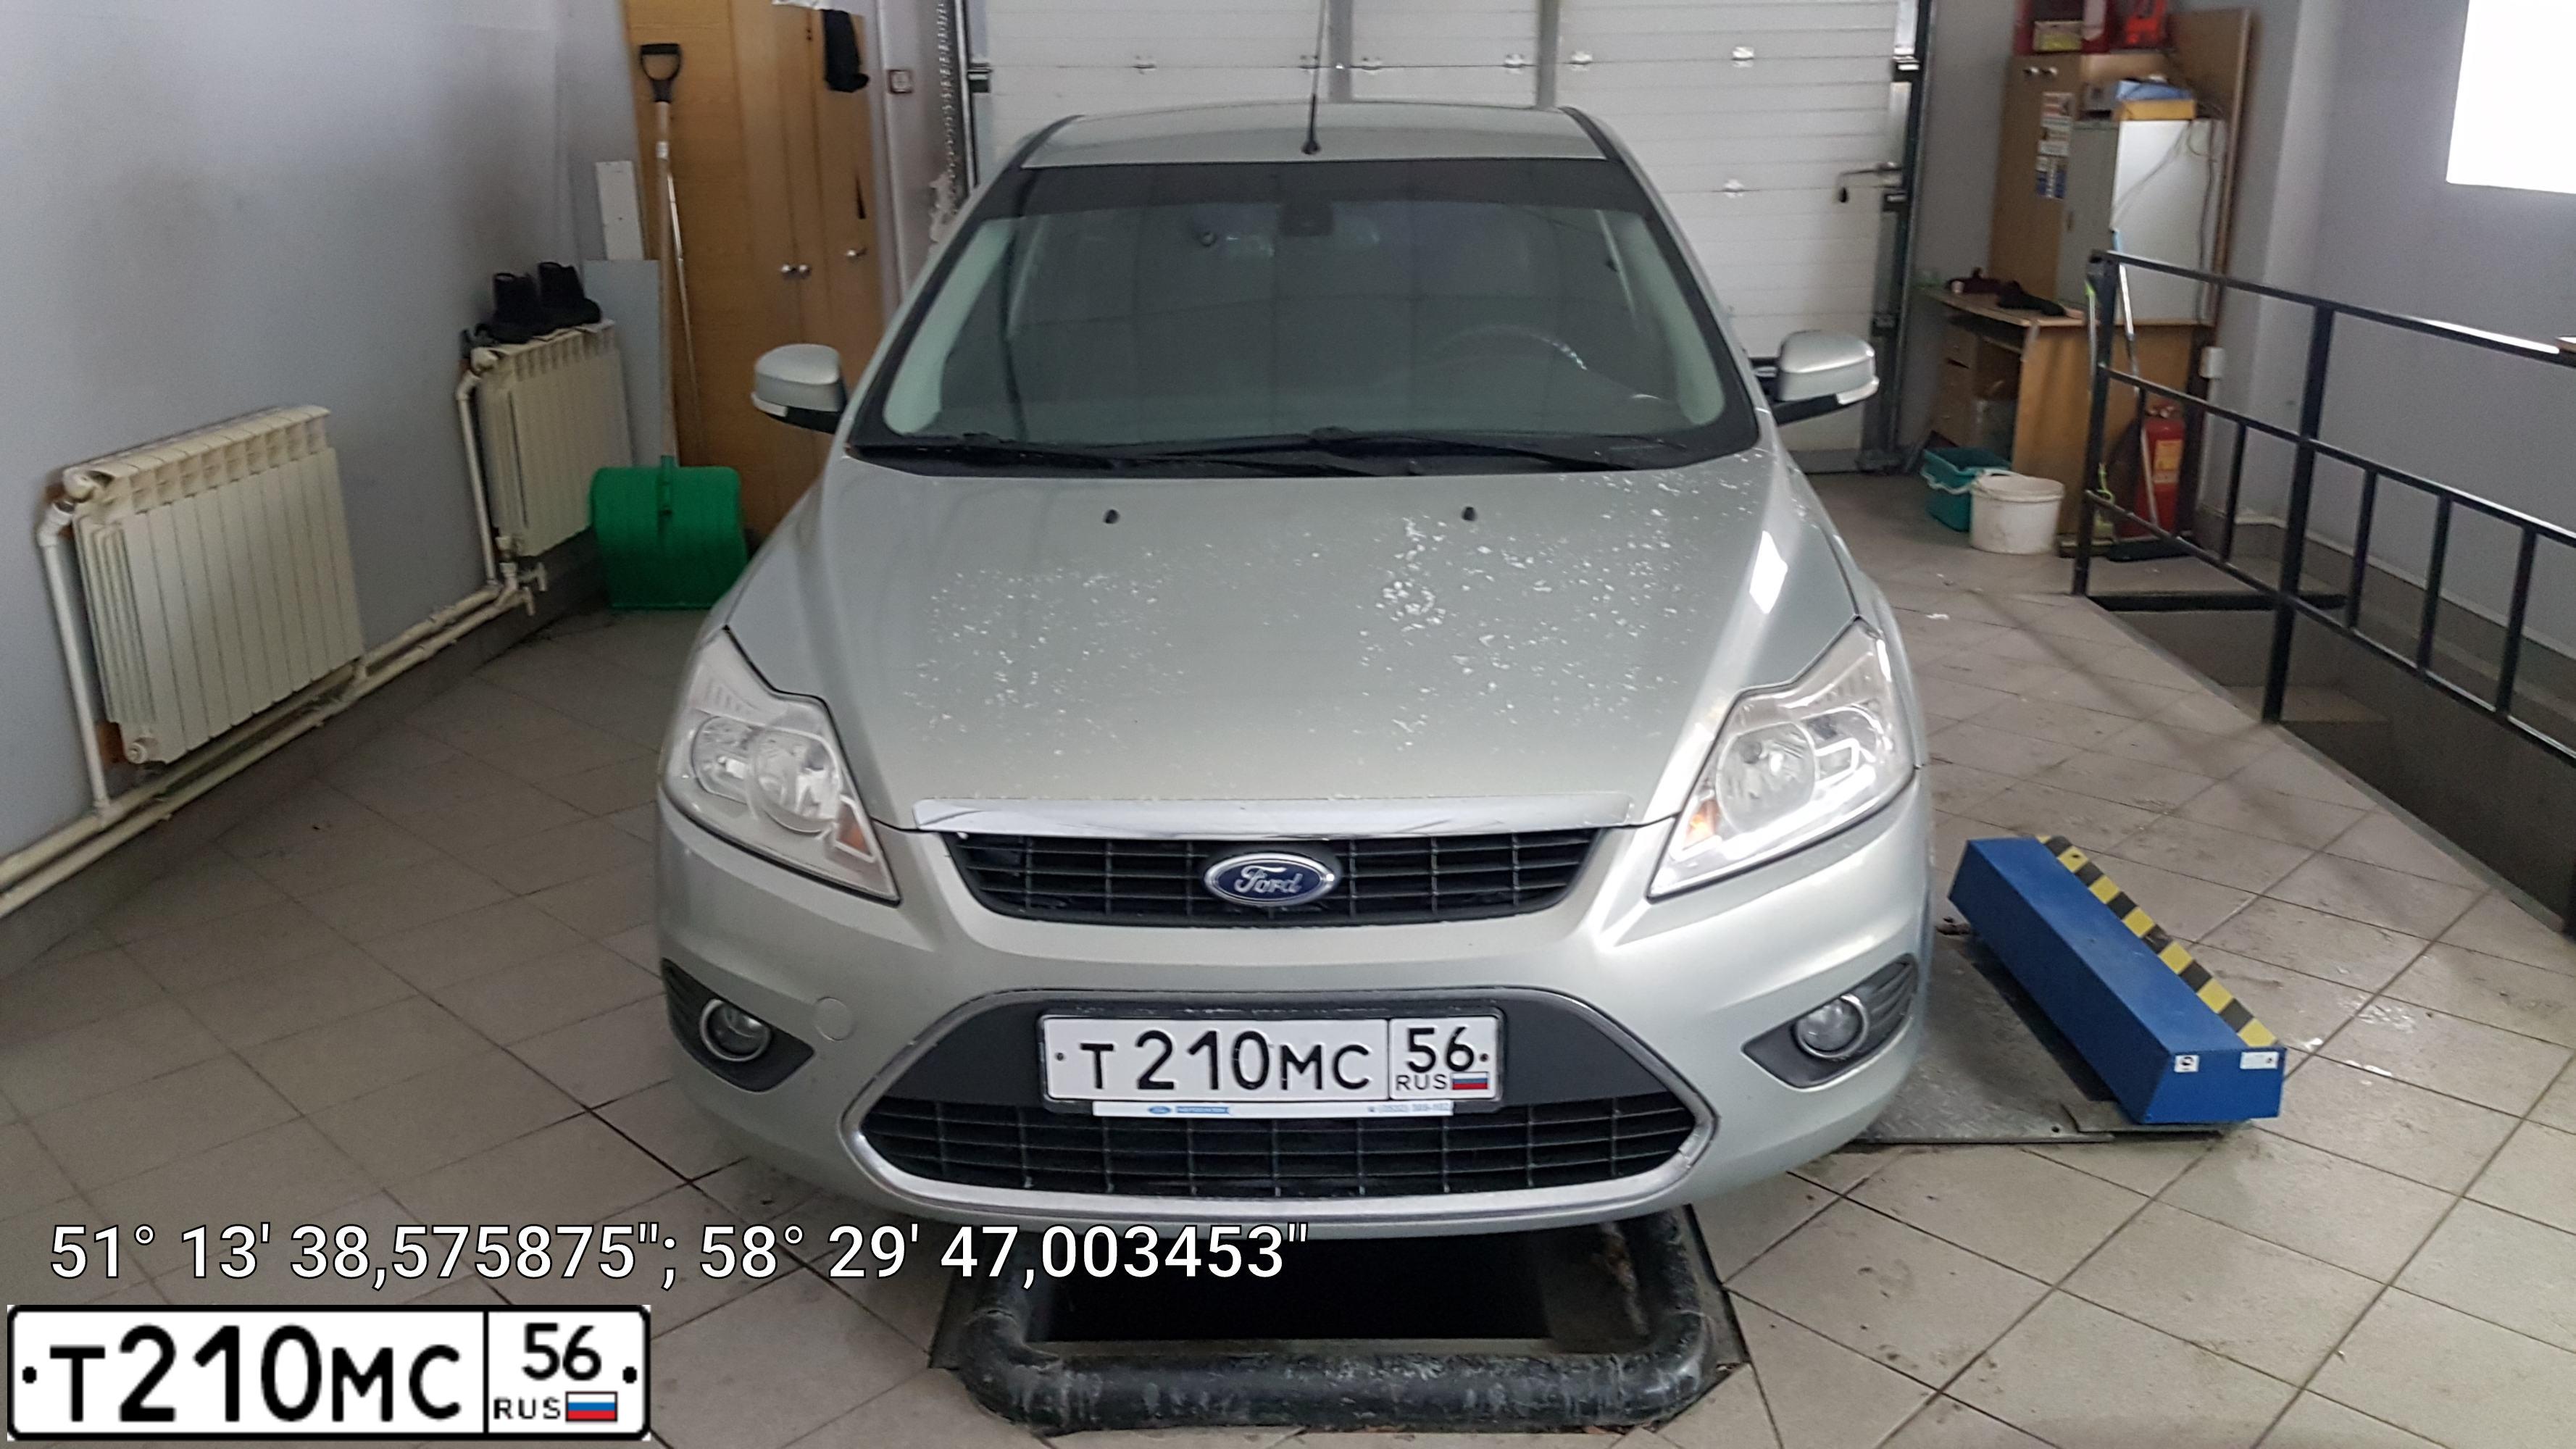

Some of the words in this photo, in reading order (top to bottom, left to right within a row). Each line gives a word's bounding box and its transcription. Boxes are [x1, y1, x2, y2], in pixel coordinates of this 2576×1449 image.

[1234, 865, 1303, 893] Ford
[1406, 1026, 1475, 1074] 56
[1396, 1074, 1447, 1090] RUS
